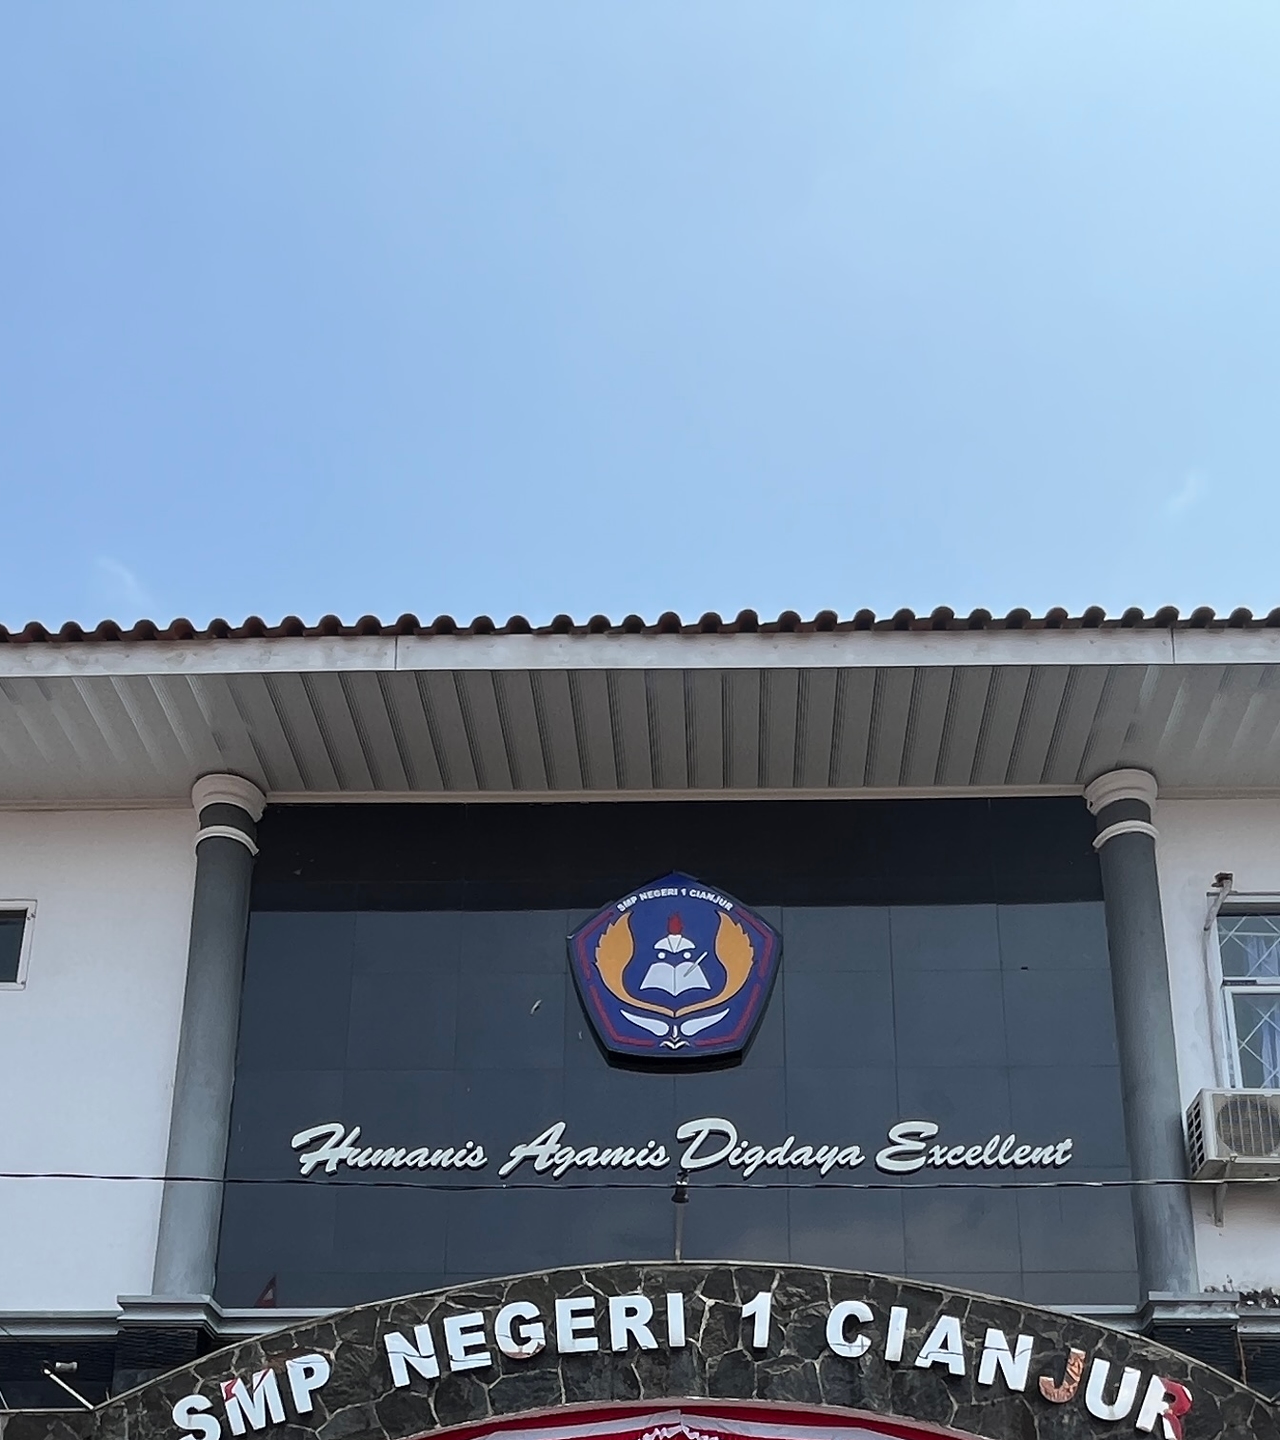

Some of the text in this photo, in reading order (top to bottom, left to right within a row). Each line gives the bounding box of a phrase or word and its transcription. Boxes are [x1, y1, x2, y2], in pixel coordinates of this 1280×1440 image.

[616, 888, 734, 912] SMP NEGERI 1 CIANJUR
[291, 1117, 1073, 1179] Humanis Agamis Digdaya Excellent
[383, 1292, 687, 1388] NEGERI
[741, 1292, 772, 1348] 1
